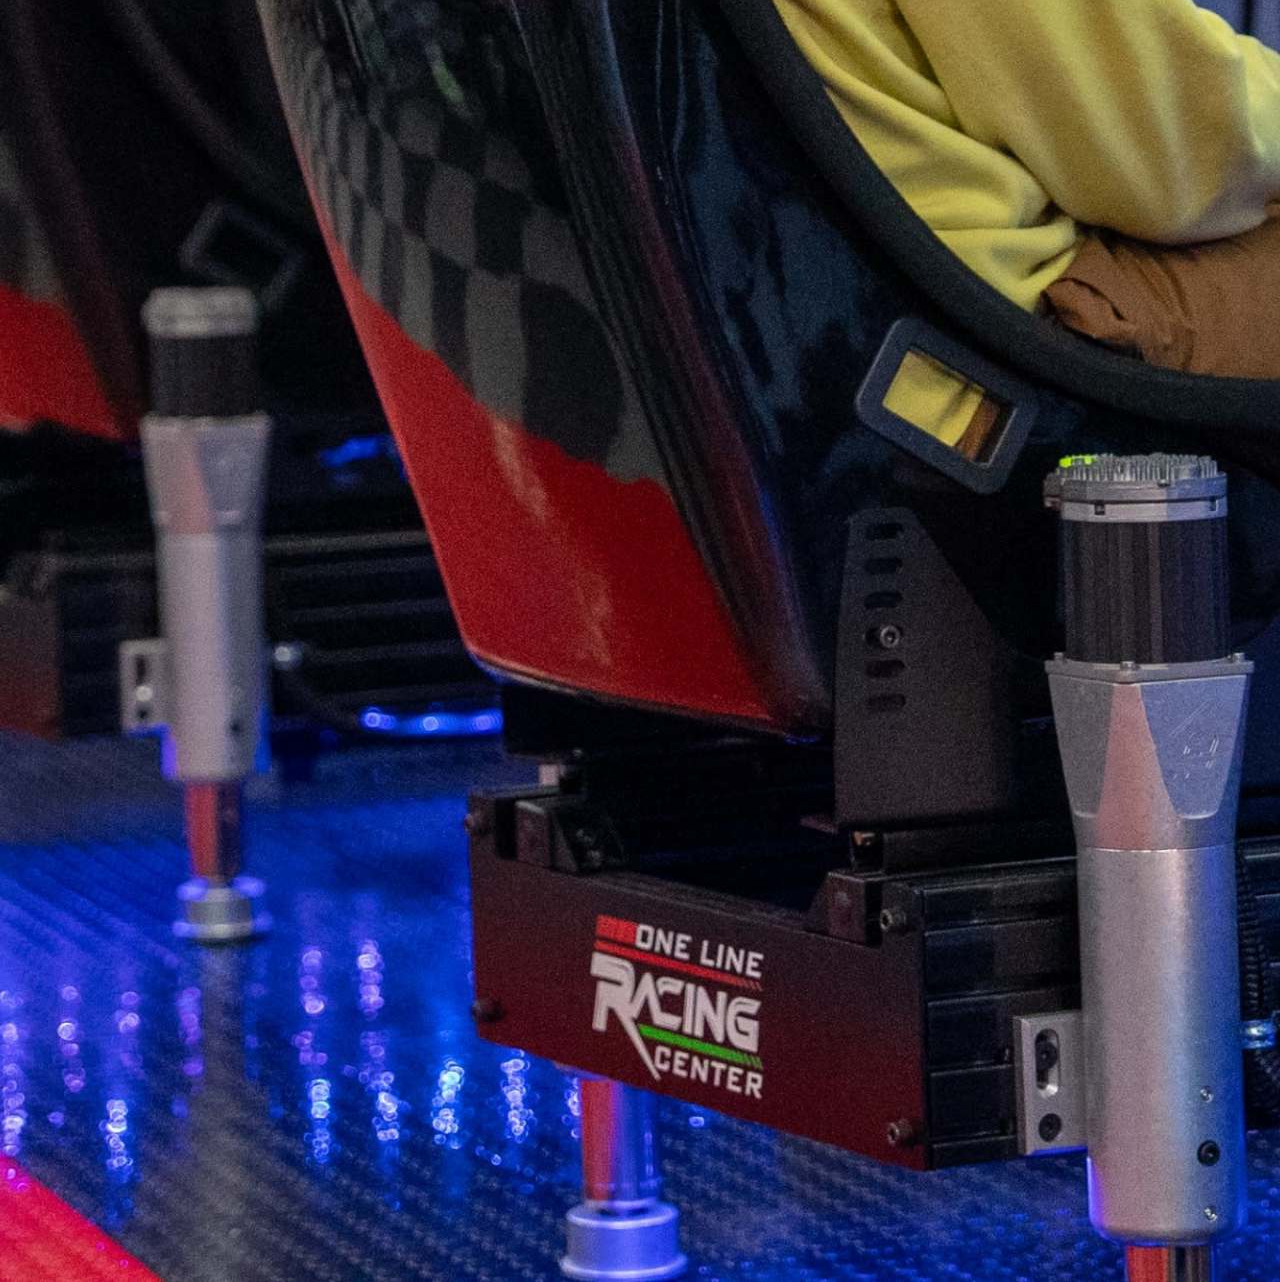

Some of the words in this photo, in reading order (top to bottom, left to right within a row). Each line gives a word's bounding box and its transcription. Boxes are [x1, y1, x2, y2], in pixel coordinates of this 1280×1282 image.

[635, 923, 692, 960] ONE
[699, 940, 764, 978] LINE
[590, 951, 761, 1081] RACING
[654, 1045, 763, 1100] CENTER
